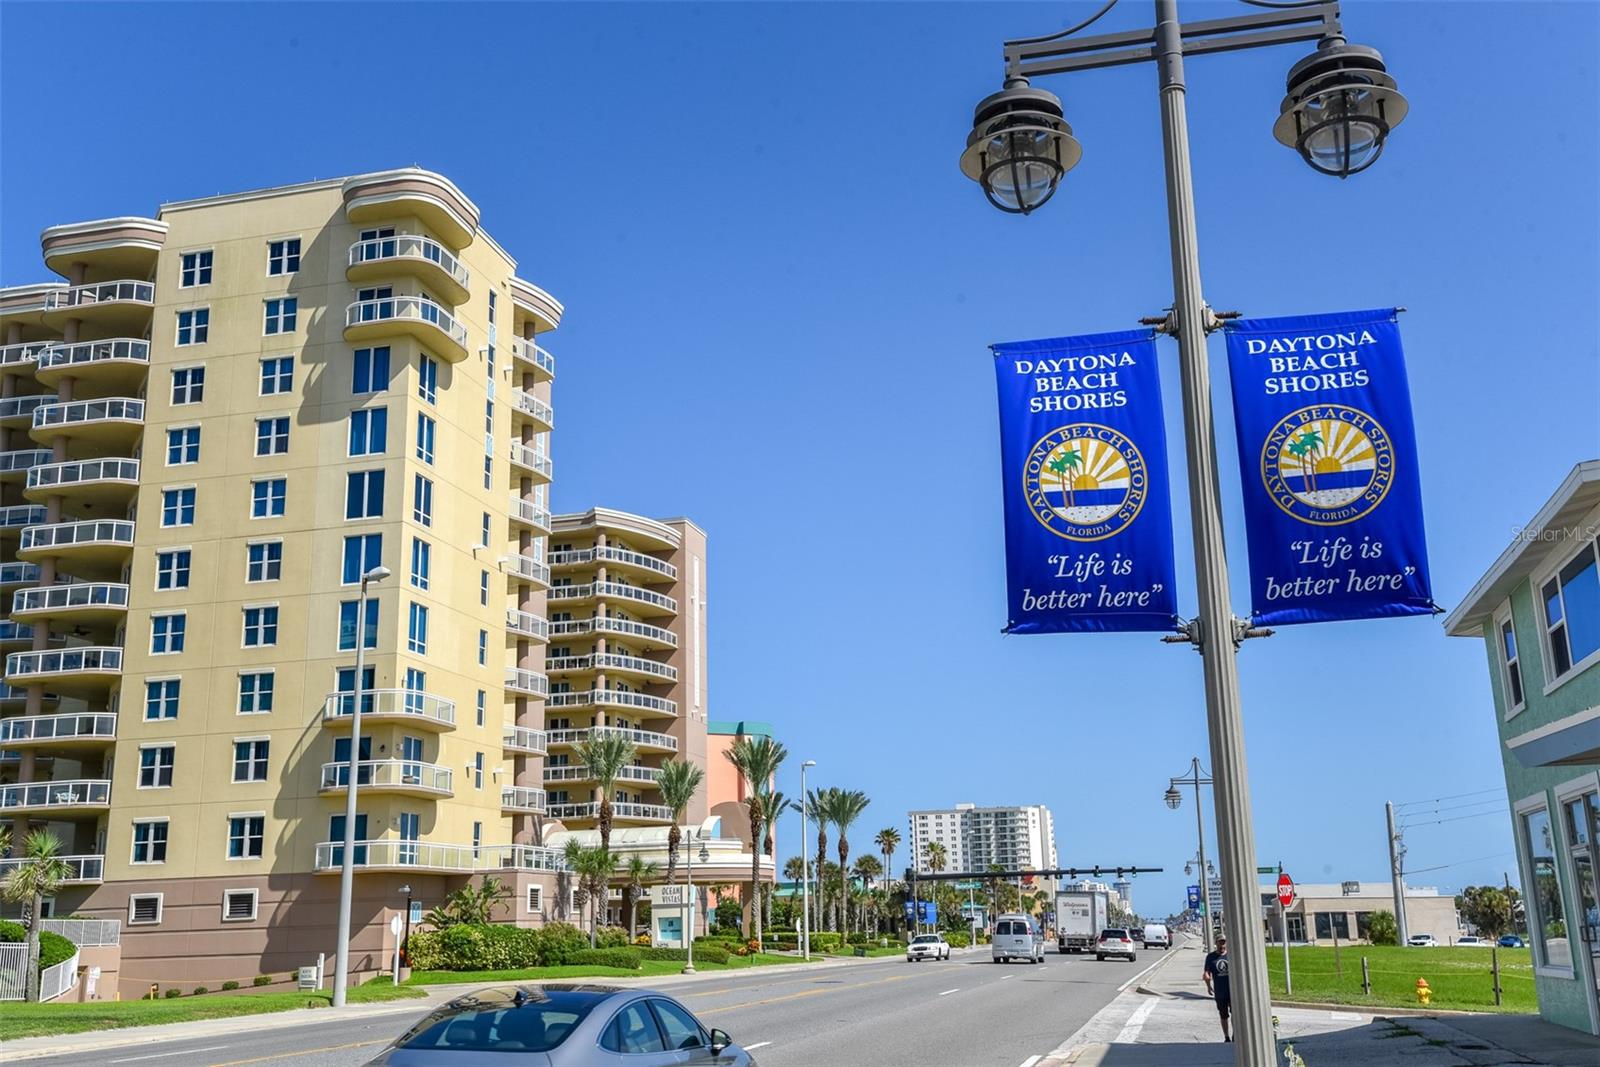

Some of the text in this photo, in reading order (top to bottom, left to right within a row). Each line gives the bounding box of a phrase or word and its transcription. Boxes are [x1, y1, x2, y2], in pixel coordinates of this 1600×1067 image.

[1247, 330, 1377, 355] DAYTONA
[1015, 351, 1136, 374] DAYTONA
[1270, 350, 1360, 373] BEACH
[1035, 371, 1119, 393] BEACH
[1265, 369, 1370, 395] SHORES
[1030, 390, 1127, 413] SHORES
[1264, 407, 1391, 510] DAYTONA BEACH SHORES
[1027, 426, 1144, 523] DAYTONA BEACH SHORES
[1308, 506, 1359, 520] FLORIDA
[1066, 524, 1112, 536] FLORIDA
[1359, 536, 1383, 559] is
[1111, 553, 1133, 575] is
[1022, 588, 1092, 611] better
[1265, 576, 1340, 601] better
[662, 886, 681, 895] OCEAN
[662, 895, 681, 903] VISTAS
[1279, 885, 1292, 896] STOP
